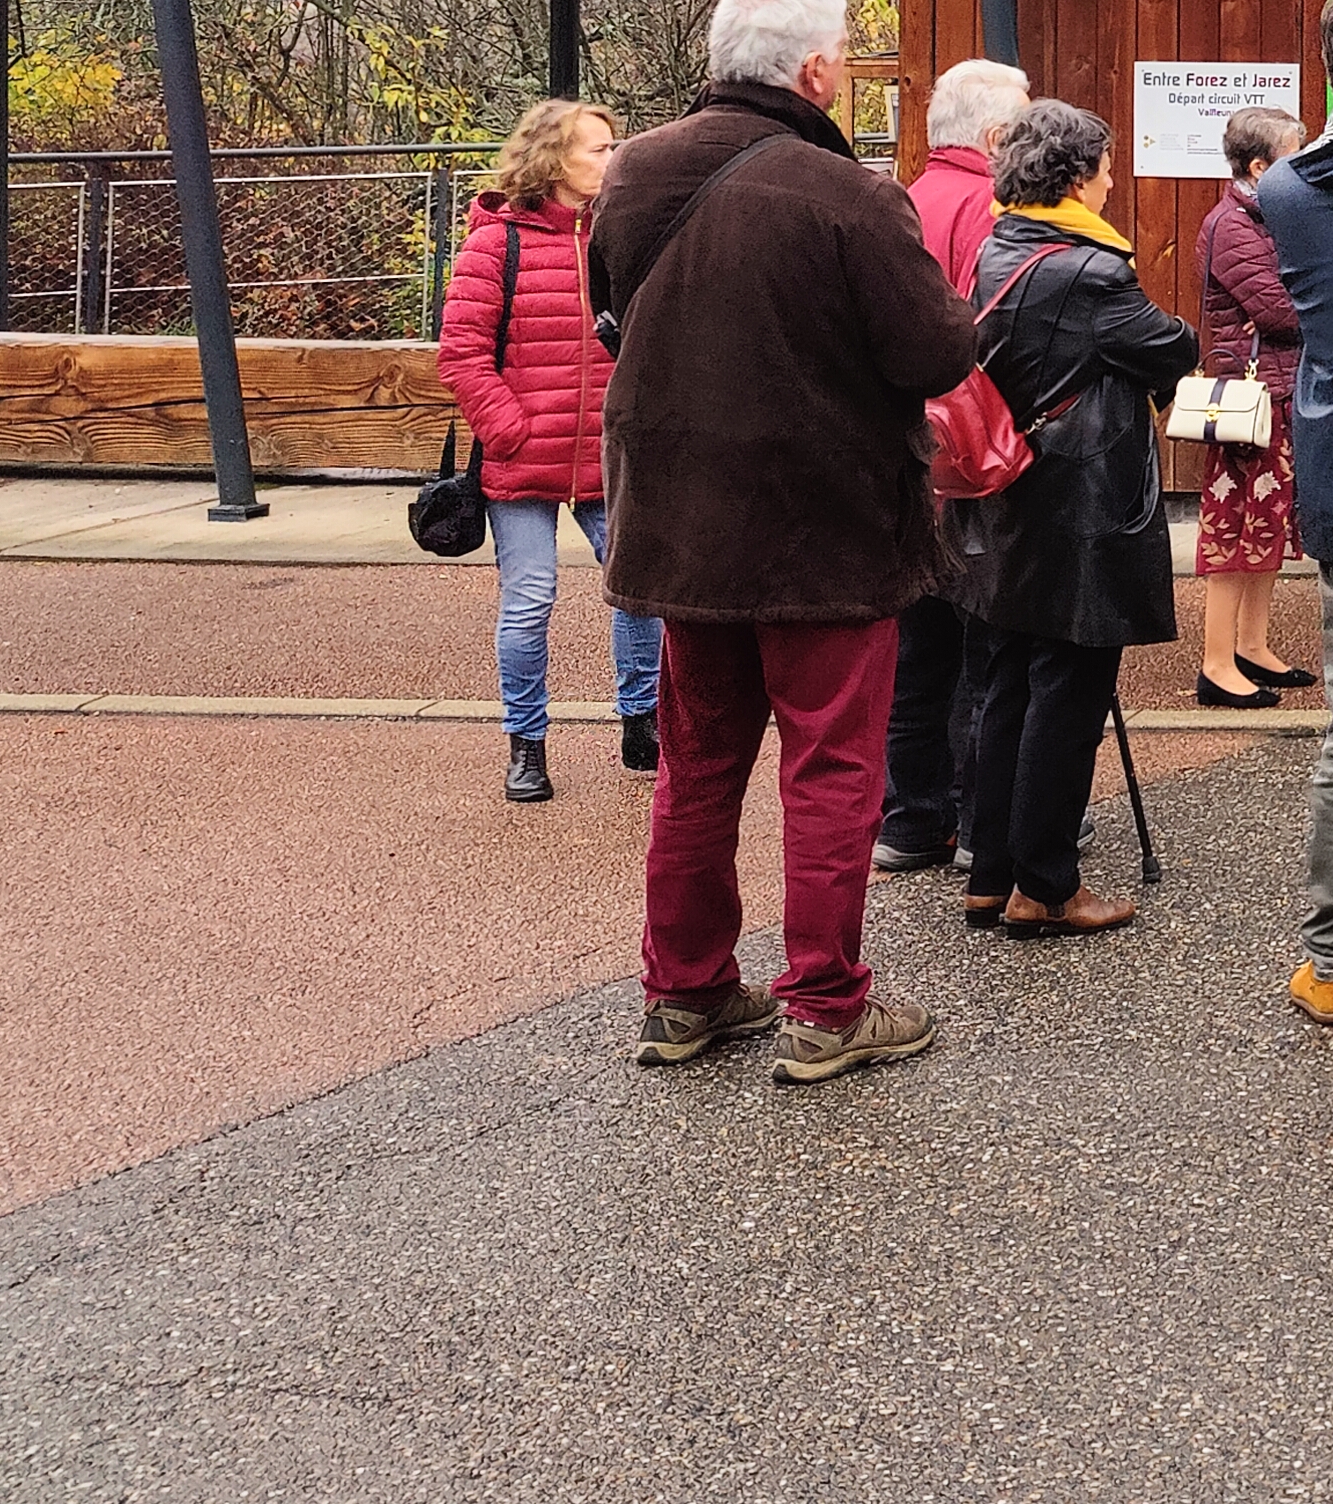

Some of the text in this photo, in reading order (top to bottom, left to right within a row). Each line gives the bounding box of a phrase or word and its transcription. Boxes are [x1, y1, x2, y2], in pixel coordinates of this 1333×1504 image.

[1143, 72, 1291, 88] Entre Forez et Jarez
[1168, 91, 1265, 107] Départ circuit VTT
